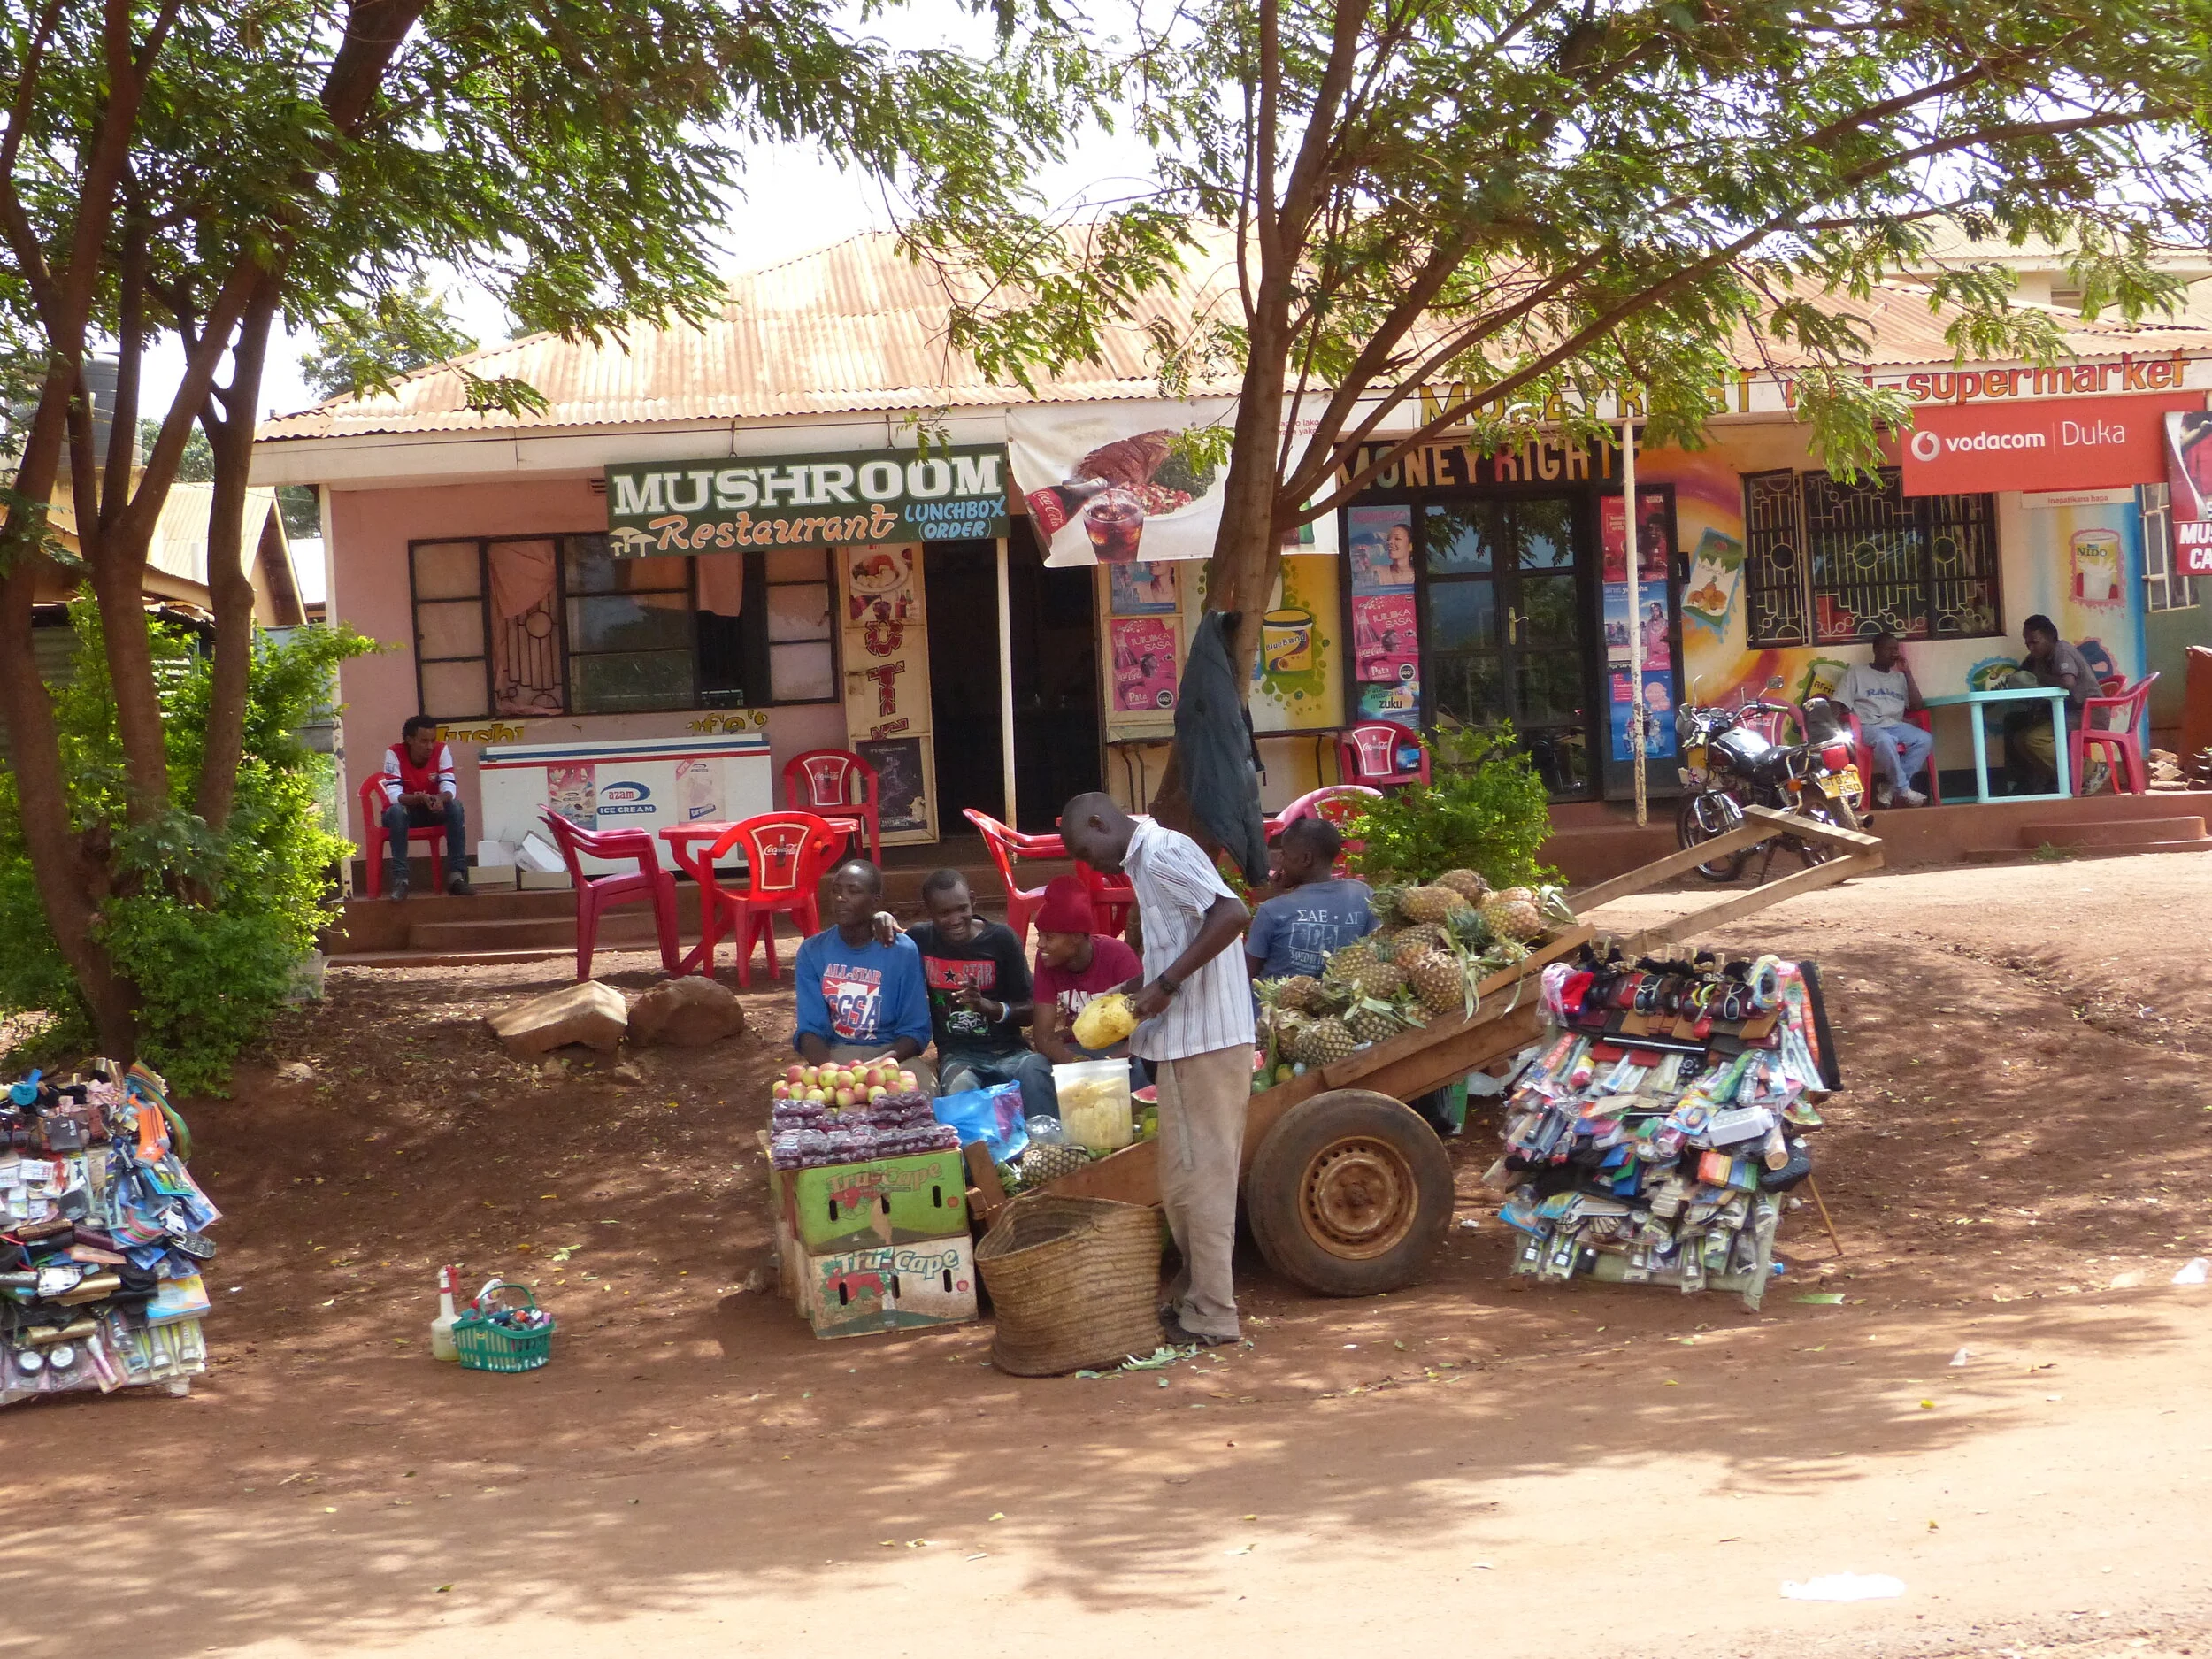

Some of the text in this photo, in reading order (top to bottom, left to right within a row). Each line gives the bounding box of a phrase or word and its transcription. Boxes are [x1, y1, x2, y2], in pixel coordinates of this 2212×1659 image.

[1946, 419, 2125, 452] vodacom Duka
[1335, 439, 1616, 490] MONEY RIGHT
[612, 454, 1003, 516] MUSHROOM
[904, 495, 1006, 523] LUNCHBOX
[648, 503, 899, 550] Restaurant
[918, 518, 992, 541] (ORDER)
[2179, 524, 2212, 545] MU
[2077, 547, 2108, 557] NIDO
[1386, 618, 1413, 628] SASA
[1144, 641, 1172, 652] SASA
[1371, 666, 1390, 675] Pata
[1128, 693, 1147, 702] Pata
[1379, 697, 1402, 709] zuku
[609, 790, 634, 800] azam
[824, 963, 882, 984] ALL-STAR
[826, 1162, 942, 1193] Tru-Cape
[835, 1249, 959, 1280] Tru-Cape
